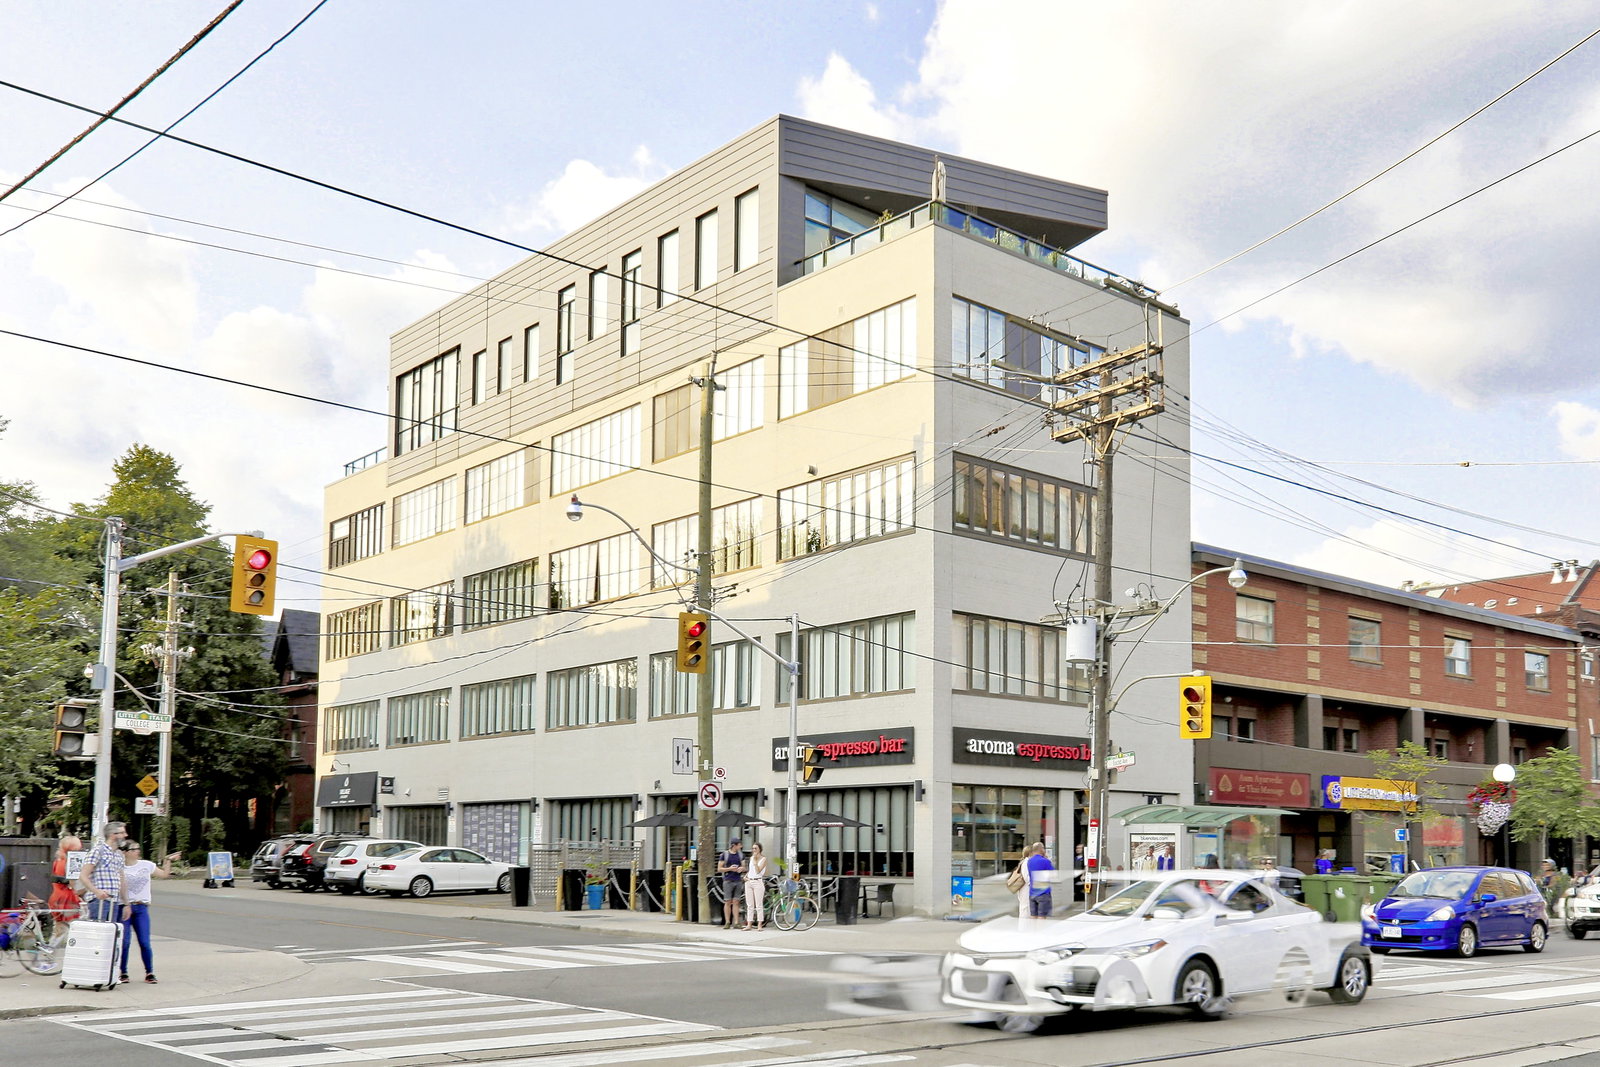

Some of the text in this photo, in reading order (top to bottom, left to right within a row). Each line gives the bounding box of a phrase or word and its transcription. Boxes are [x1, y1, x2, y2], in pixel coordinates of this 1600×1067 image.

[126, 720, 149, 728] COLLEGE
[879, 735, 905, 753] bar
[968, 738, 1015, 755] aroma
[1018, 743, 1081, 762] espresso
